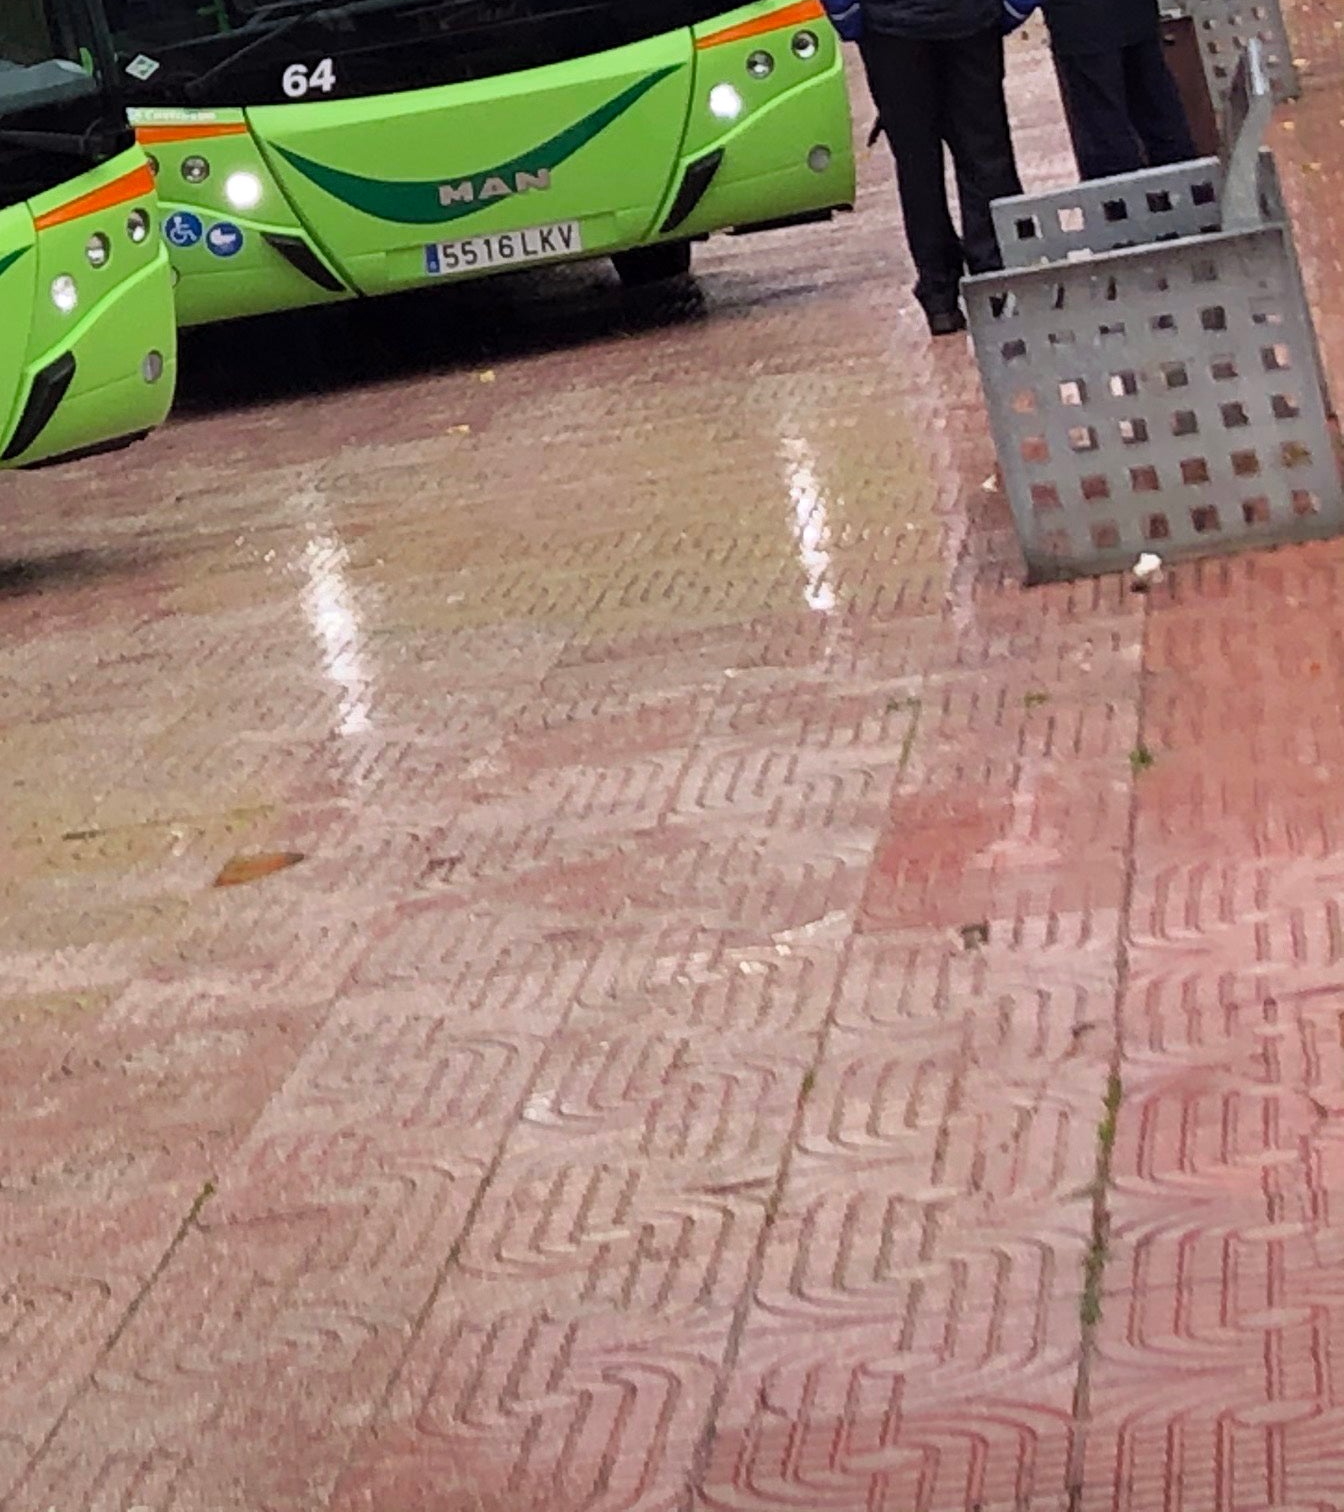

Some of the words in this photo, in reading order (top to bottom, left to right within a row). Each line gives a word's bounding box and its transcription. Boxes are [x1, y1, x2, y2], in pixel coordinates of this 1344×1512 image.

[282, 58, 335, 97] 64
[438, 168, 550, 207] MAN
[441, 238, 514, 271] 5516
[521, 224, 574, 258] LKV
